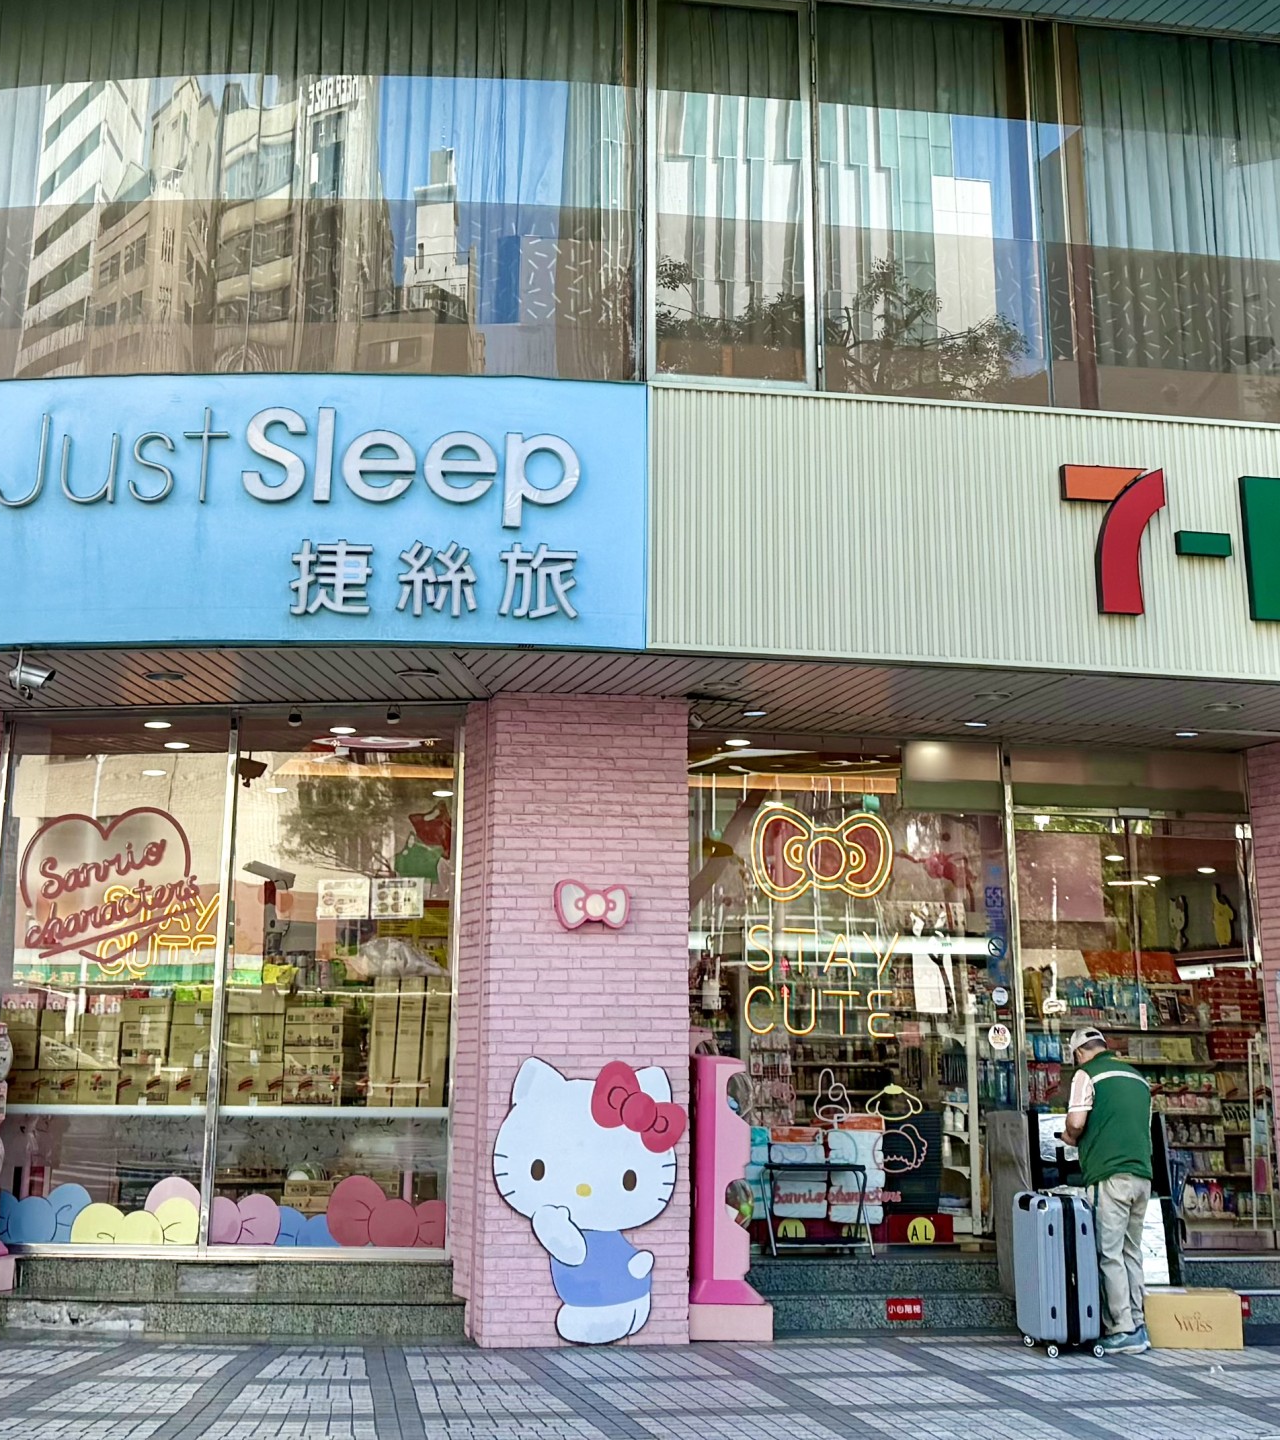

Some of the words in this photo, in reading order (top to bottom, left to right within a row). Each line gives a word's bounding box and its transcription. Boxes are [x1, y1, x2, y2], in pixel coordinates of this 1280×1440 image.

[241, 405, 582, 529] Sleep
[288, 537, 580, 620] 捷絲旅
[39, 838, 167, 900] Sanrio
[24, 874, 201, 949] characters
[745, 924, 899, 978] STAY
[744, 985, 896, 1038] CUTE
[773, 1183, 827, 1205] Sanrio
